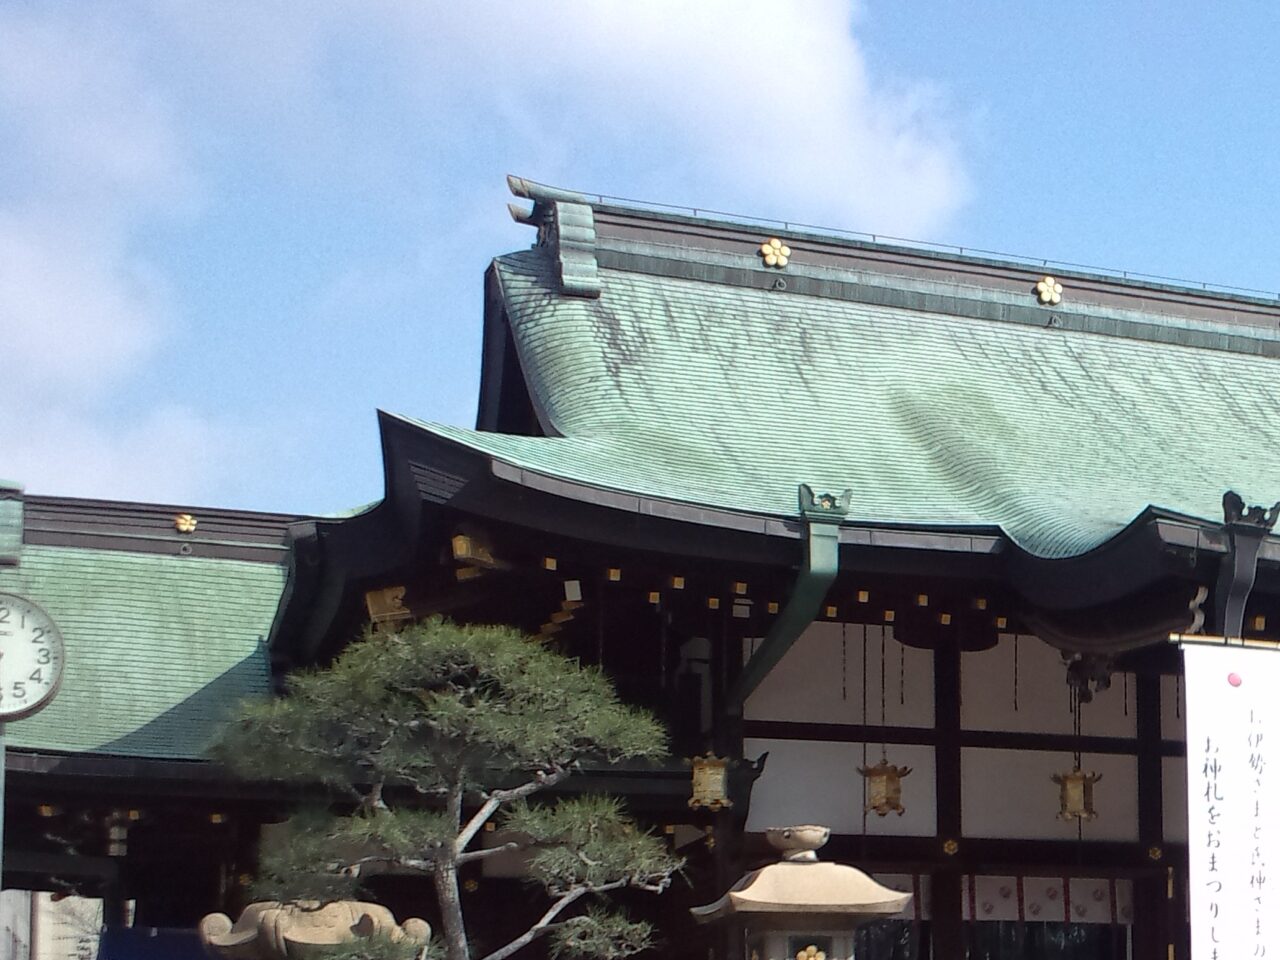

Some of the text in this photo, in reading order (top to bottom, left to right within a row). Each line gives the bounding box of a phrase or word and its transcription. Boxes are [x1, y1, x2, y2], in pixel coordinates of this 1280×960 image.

[32, 627, 45, 644] 2
[37, 648, 50, 665] 3
[29, 668, 43, 684] 4
[12, 681, 26, 698] 5
